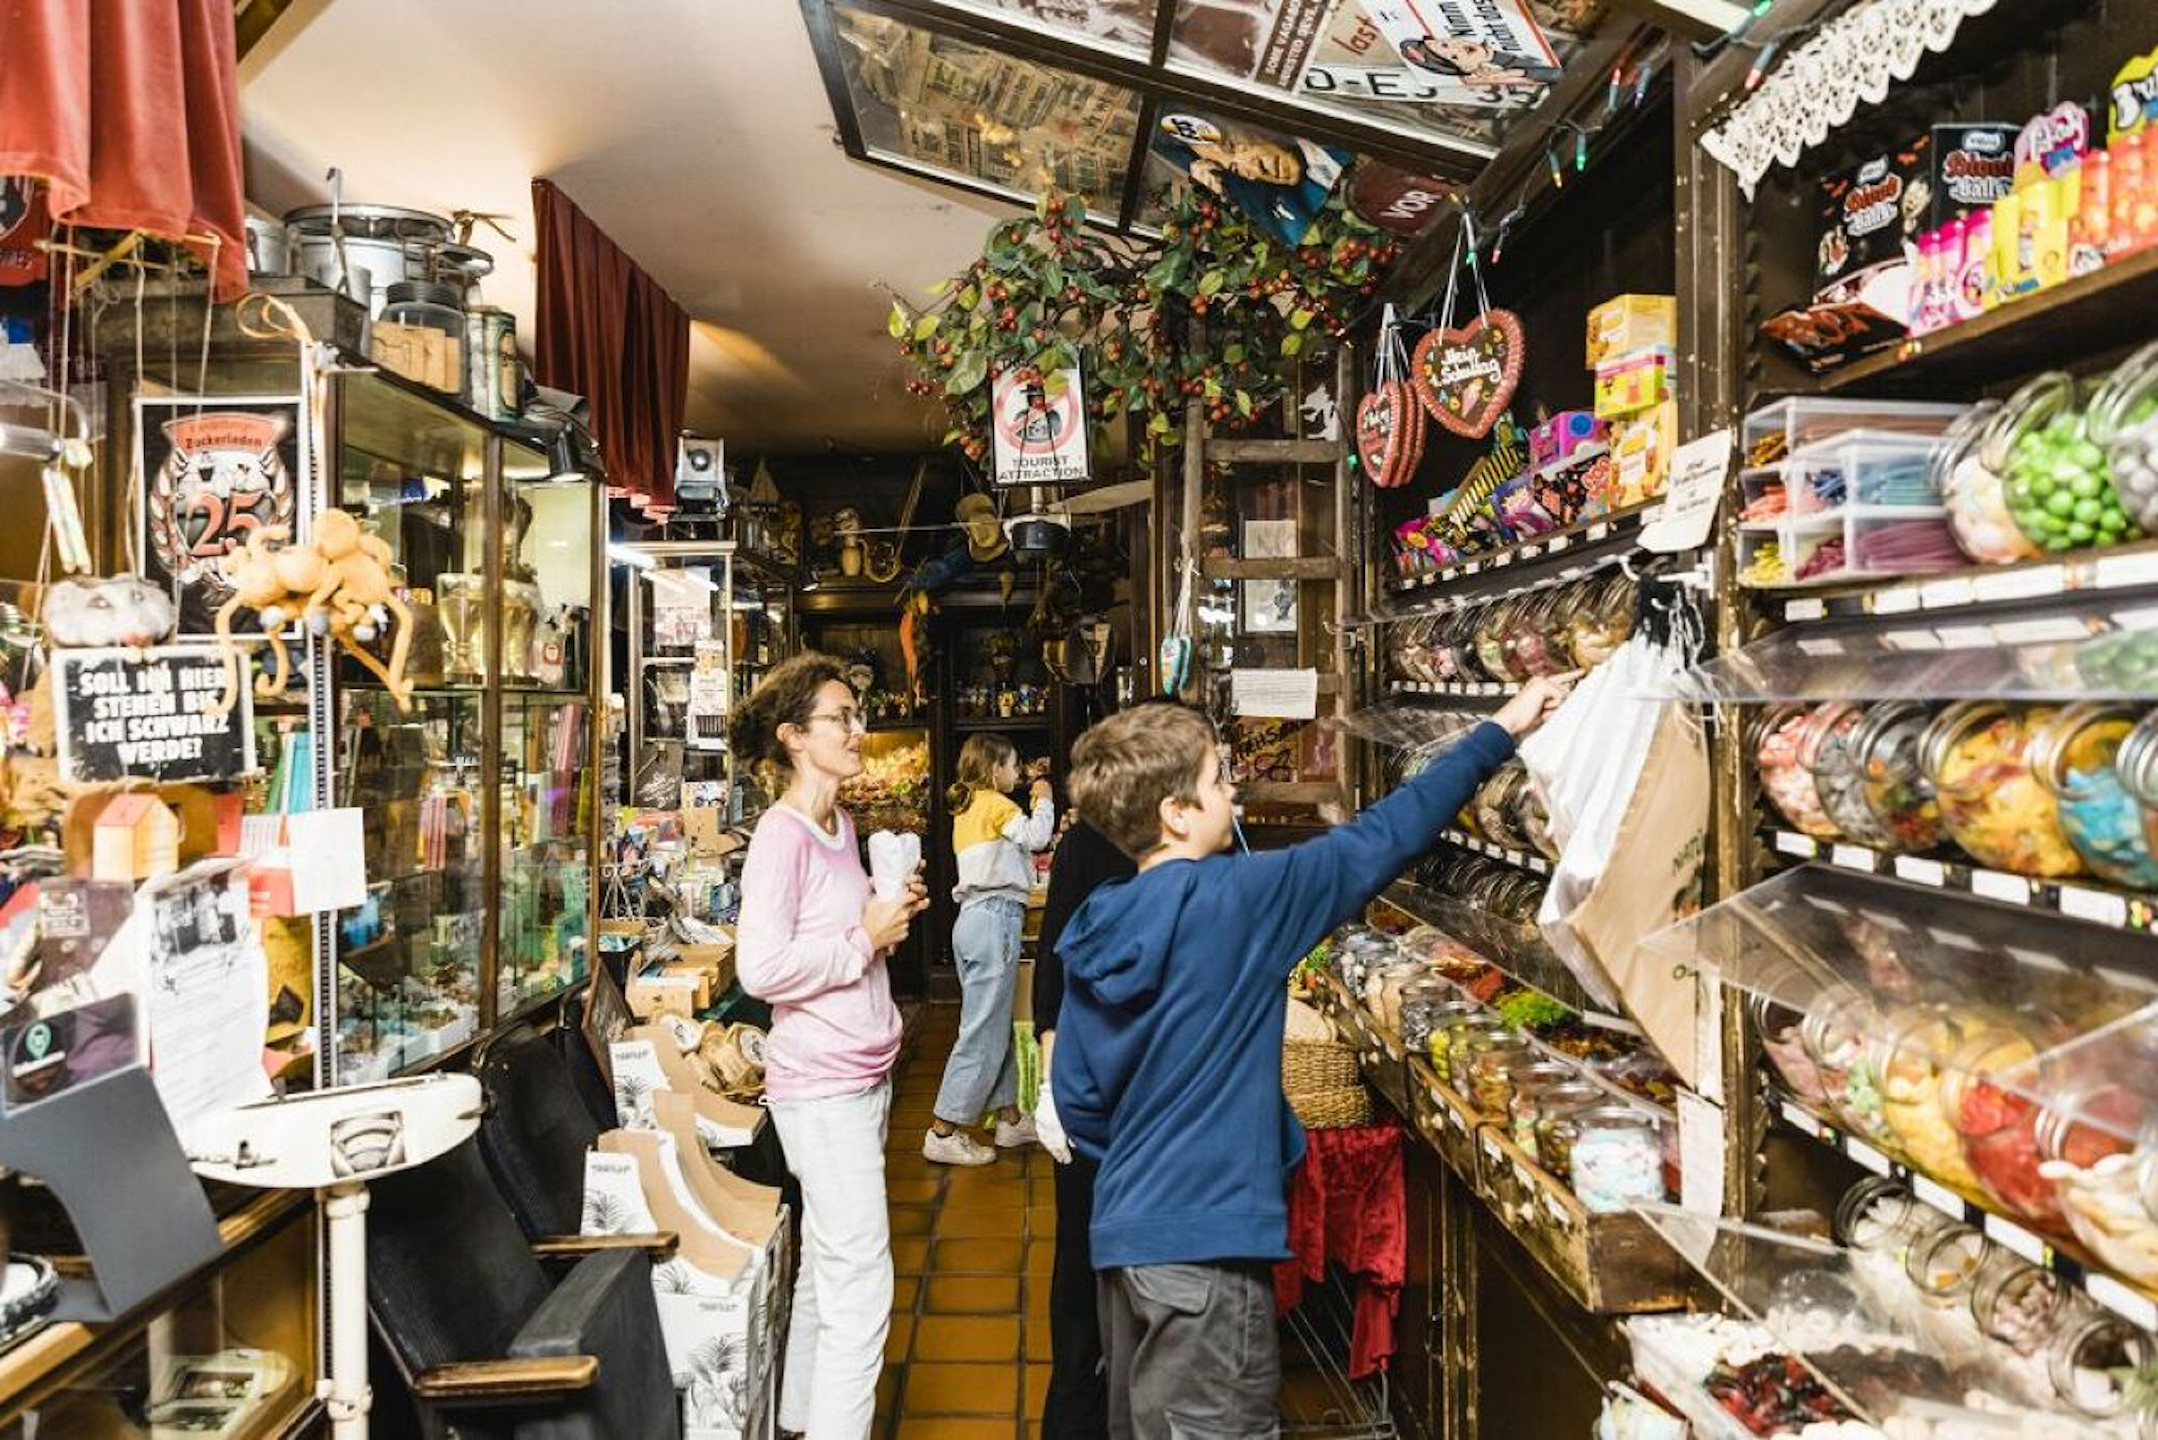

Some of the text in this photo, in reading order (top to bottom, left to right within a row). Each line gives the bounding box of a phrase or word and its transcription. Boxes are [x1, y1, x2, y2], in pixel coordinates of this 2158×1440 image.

[1000, 467, 1083, 480] ATTRACTION
[1012, 455, 1069, 467] TOURIST
[79, 671, 131, 696] SOLL
[94, 692, 176, 719] STEHEN
[85, 714, 230, 743] ICH SCHWARZ
